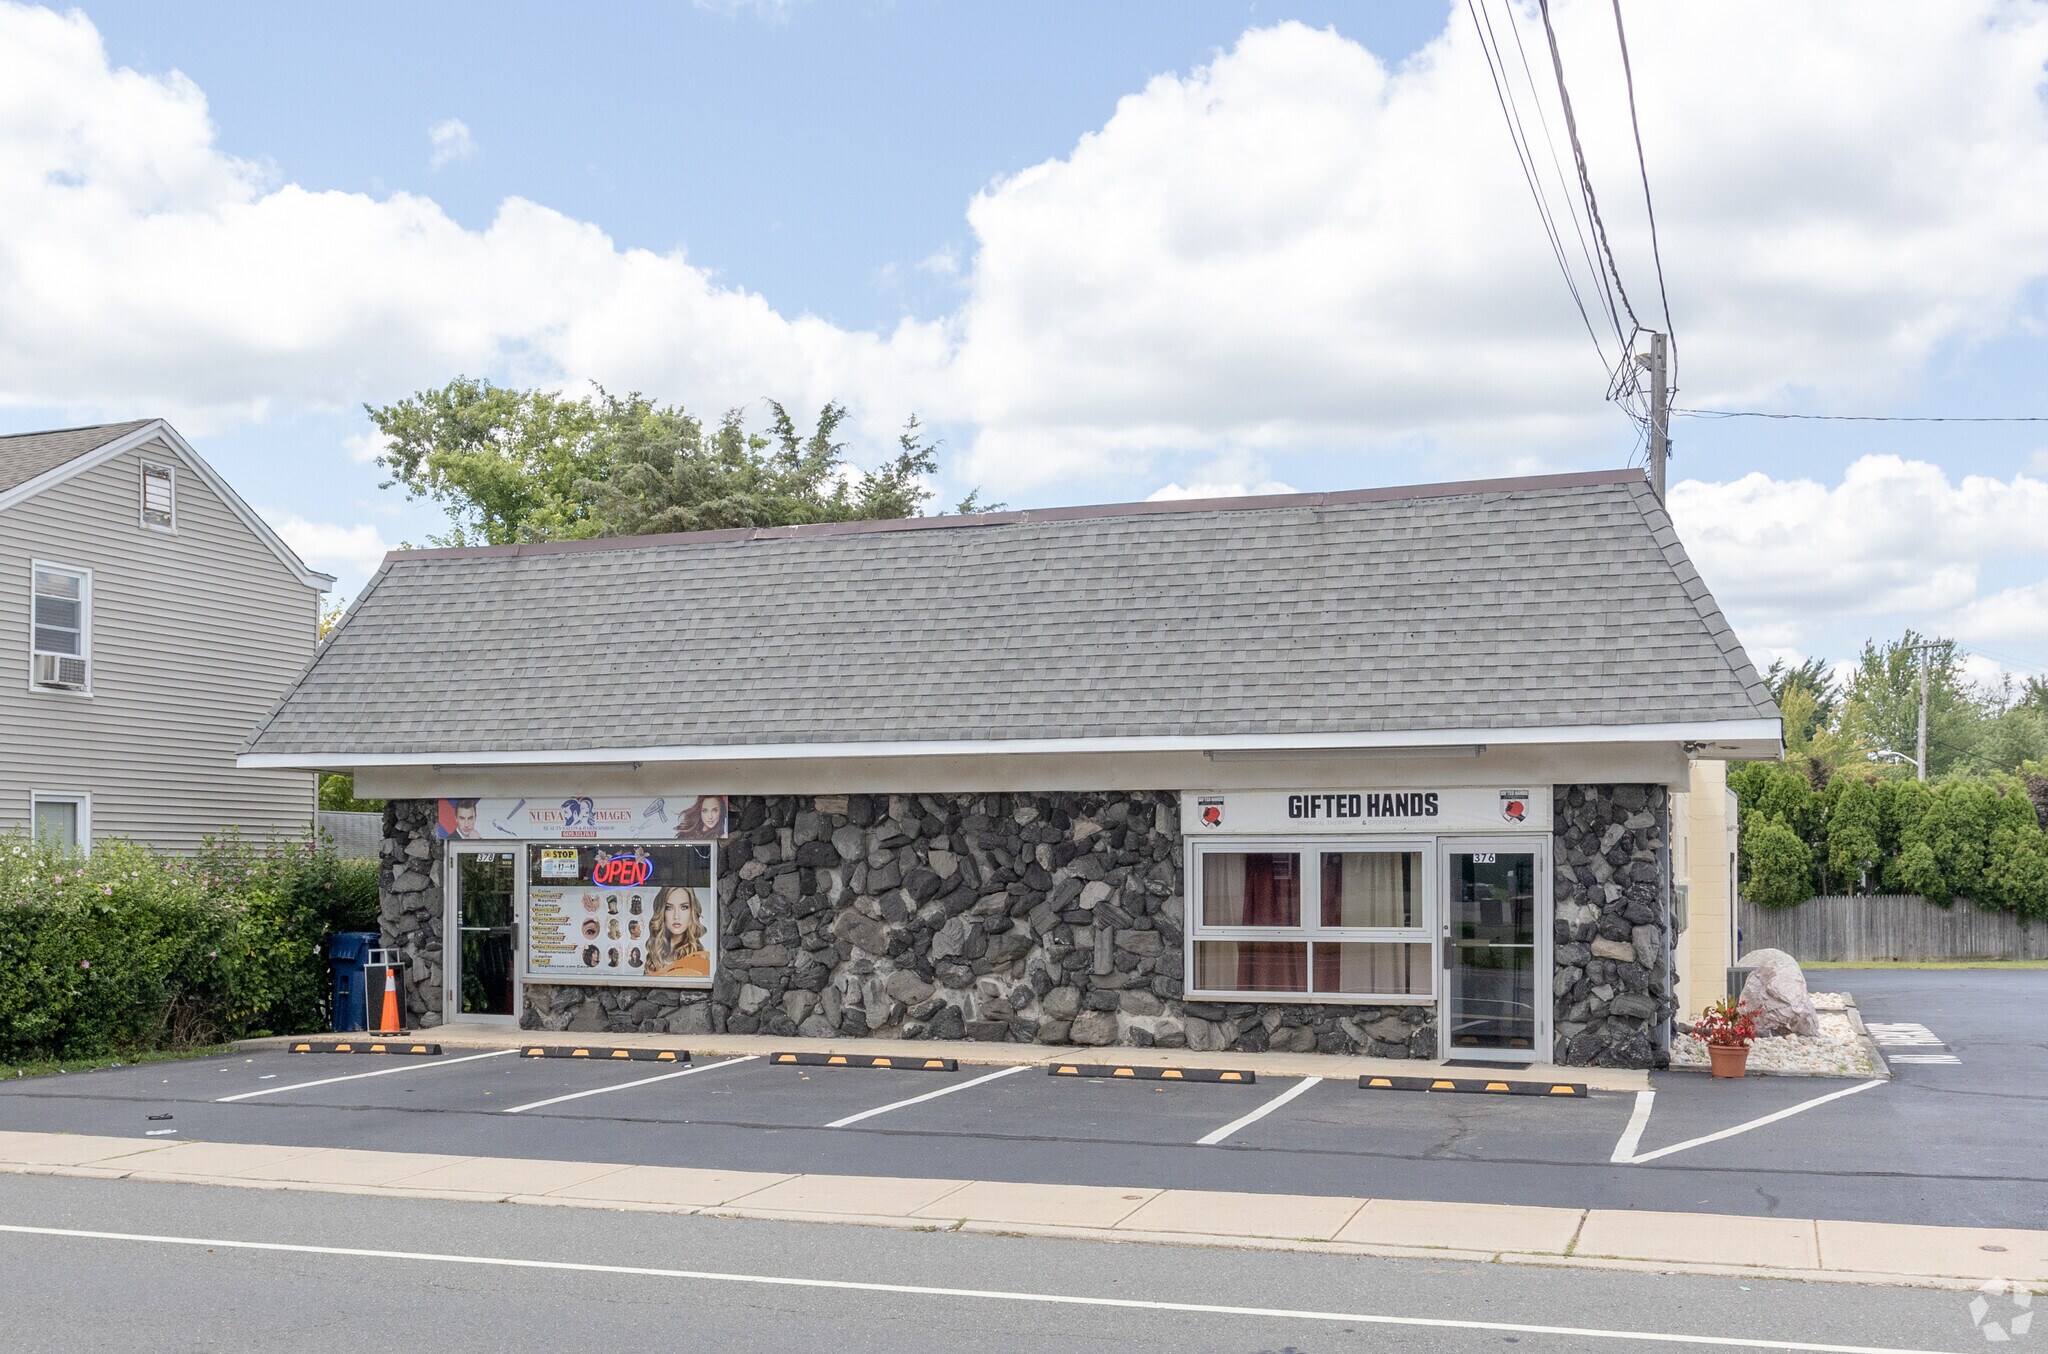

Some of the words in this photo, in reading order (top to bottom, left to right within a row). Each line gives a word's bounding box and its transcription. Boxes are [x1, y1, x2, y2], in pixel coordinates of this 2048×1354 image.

[1288, 794, 1361, 818] GIFTED
[1367, 793, 1439, 817] HANDS
[529, 810, 564, 821] NUEVA
[595, 810, 632, 820] IMAGEN
[1391, 818, 1439, 826] REHABILITATION
[477, 853, 495, 862] 378
[553, 850, 574, 859] STOP
[1474, 853, 1495, 862] 376
[593, 860, 647, 885] OPEN
